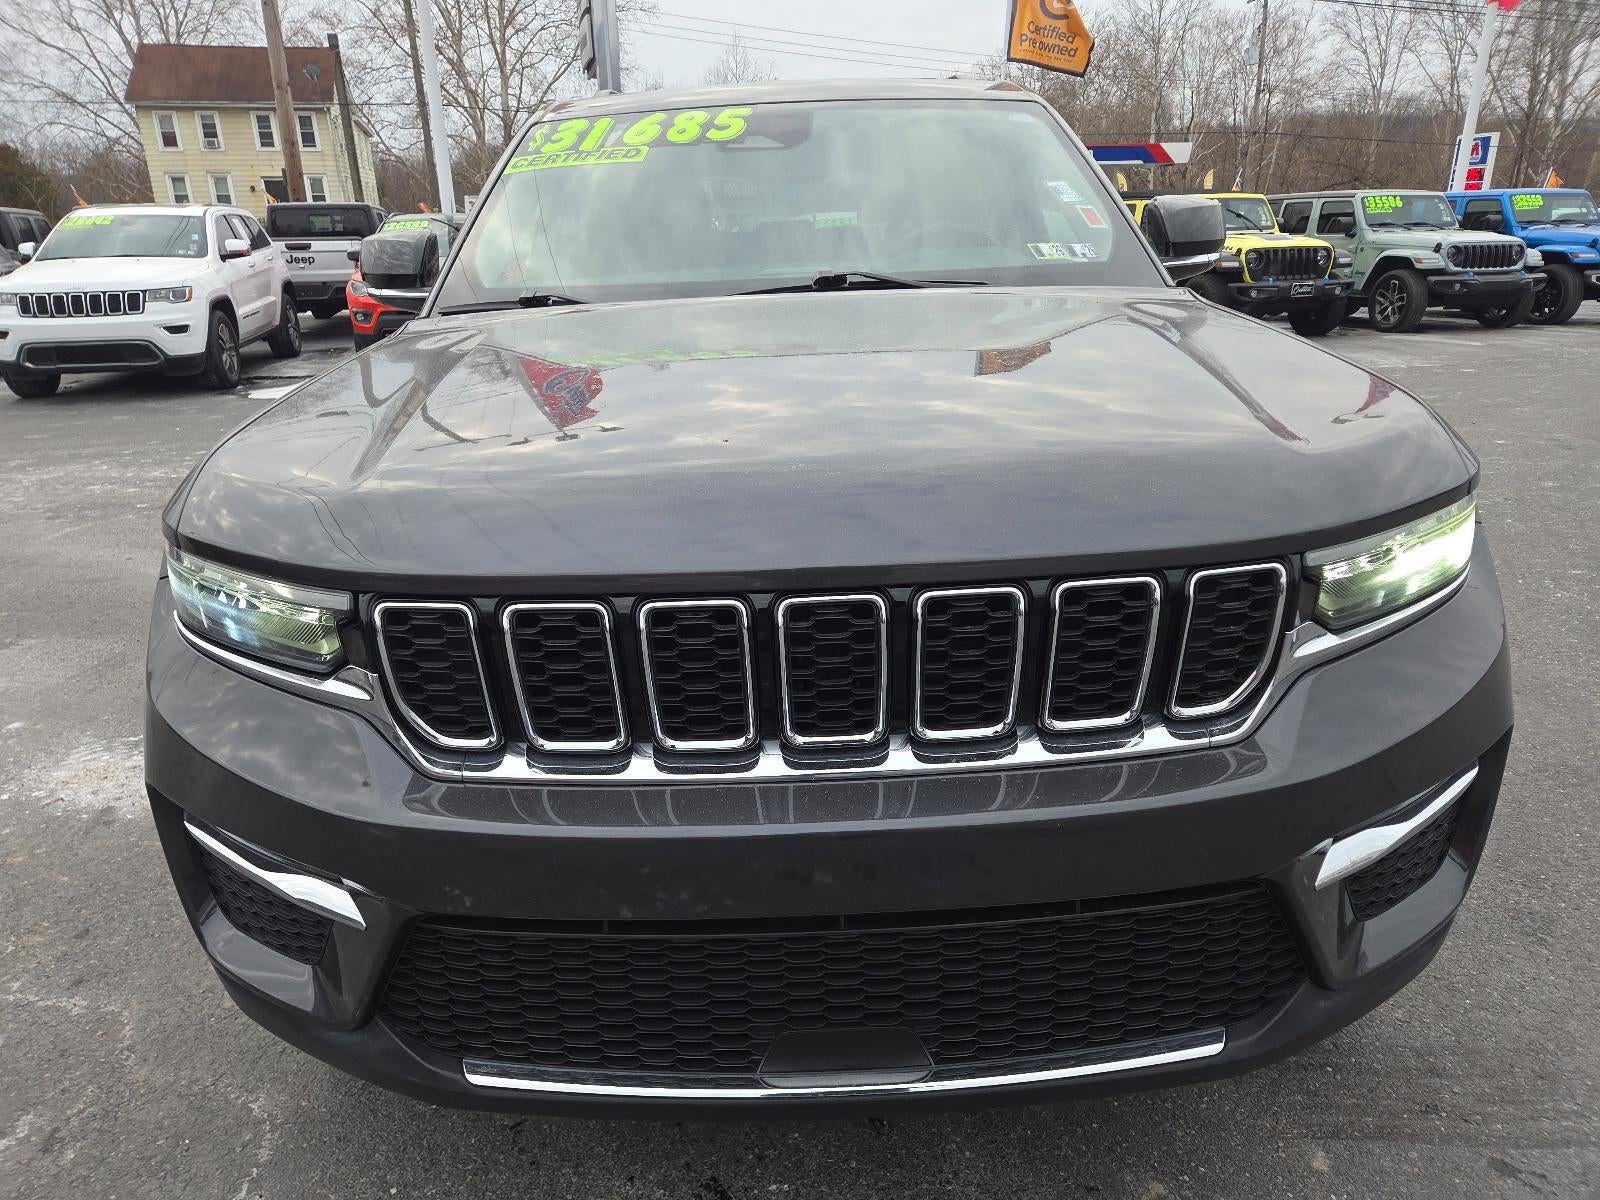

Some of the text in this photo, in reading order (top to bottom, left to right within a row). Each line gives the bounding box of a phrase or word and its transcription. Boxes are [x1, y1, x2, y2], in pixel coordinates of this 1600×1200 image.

[1027, 21, 1076, 44] Certified
[509, 147, 642, 171] CERTIFIED
[285, 254, 316, 266] Jeep
